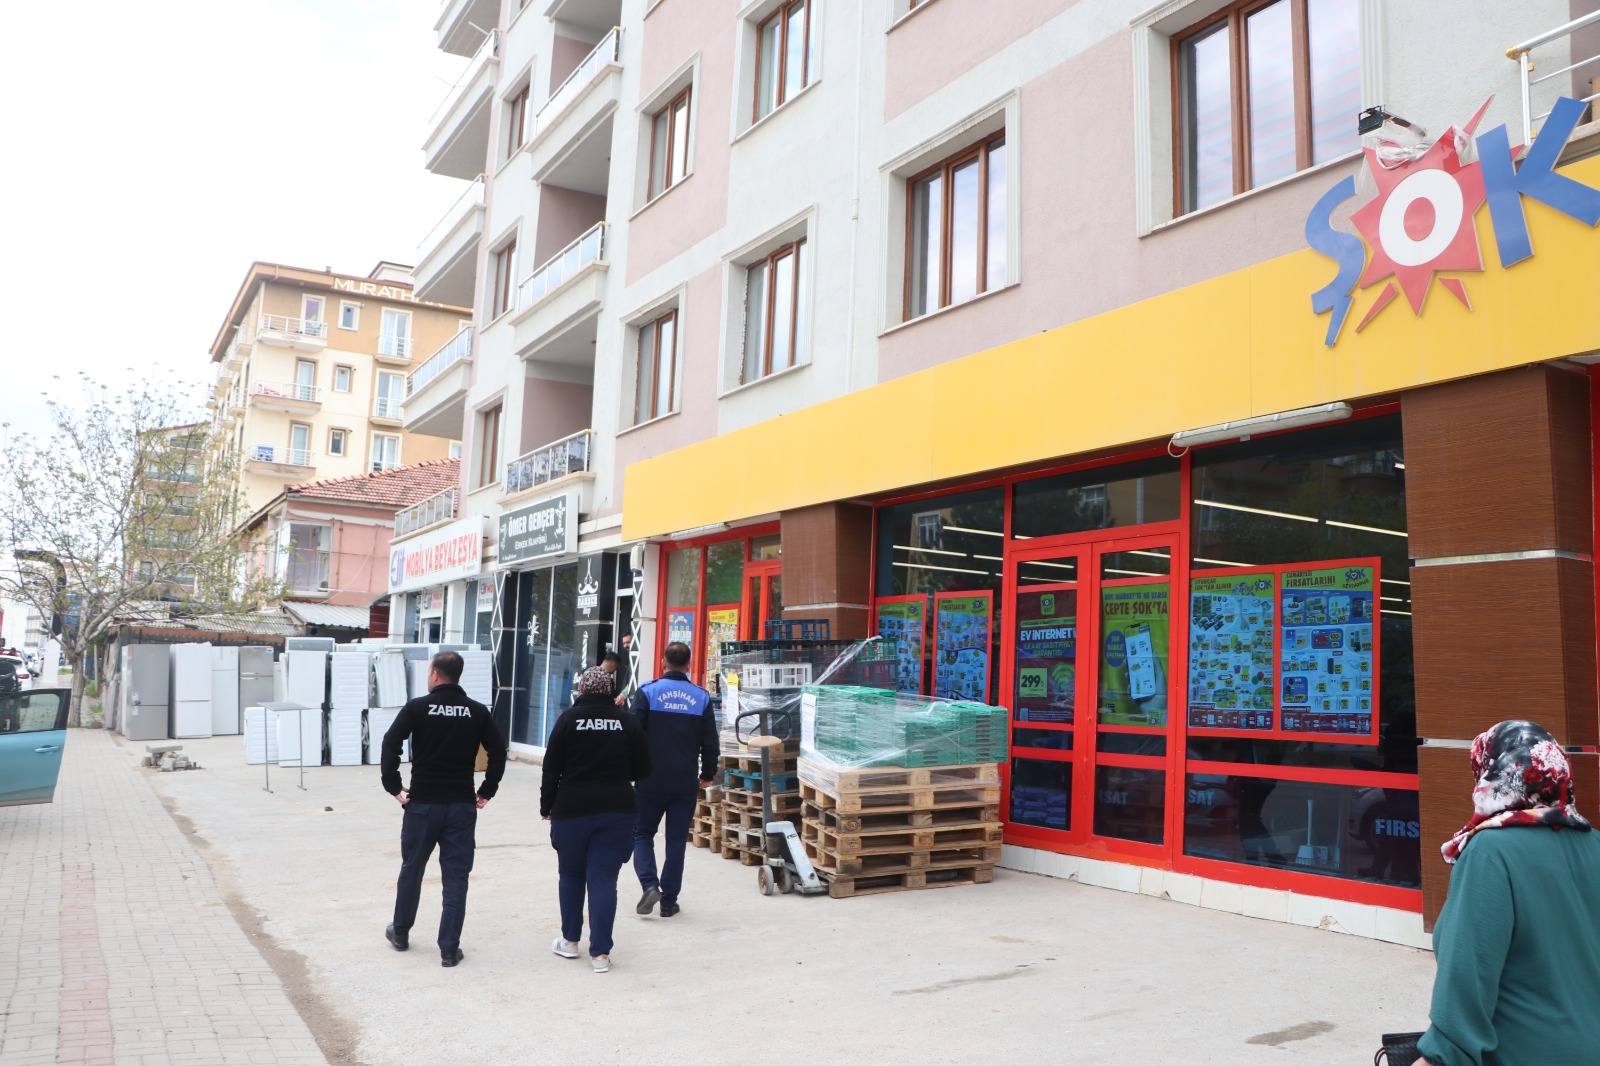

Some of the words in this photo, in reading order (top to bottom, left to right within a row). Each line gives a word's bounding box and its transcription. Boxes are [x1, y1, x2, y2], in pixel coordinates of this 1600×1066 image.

[1305, 96, 1600, 347] ŞOK
[508, 516, 527, 538] ÖMER
[528, 508, 555, 532] GENÇER
[406, 544, 433, 579] MOBİLYA
[434, 538, 457, 572] BEYAZ
[1286, 576, 1336, 587] FIRSATLARINI
[1105, 602, 1130, 615] CEPTE
[1020, 630, 1032, 641] EV
[657, 690, 697, 706] YAHŞİHAN
[428, 704, 472, 718] ZABITA
[664, 702, 688, 711] ZABITA
[576, 718, 623, 731] ZABITA
